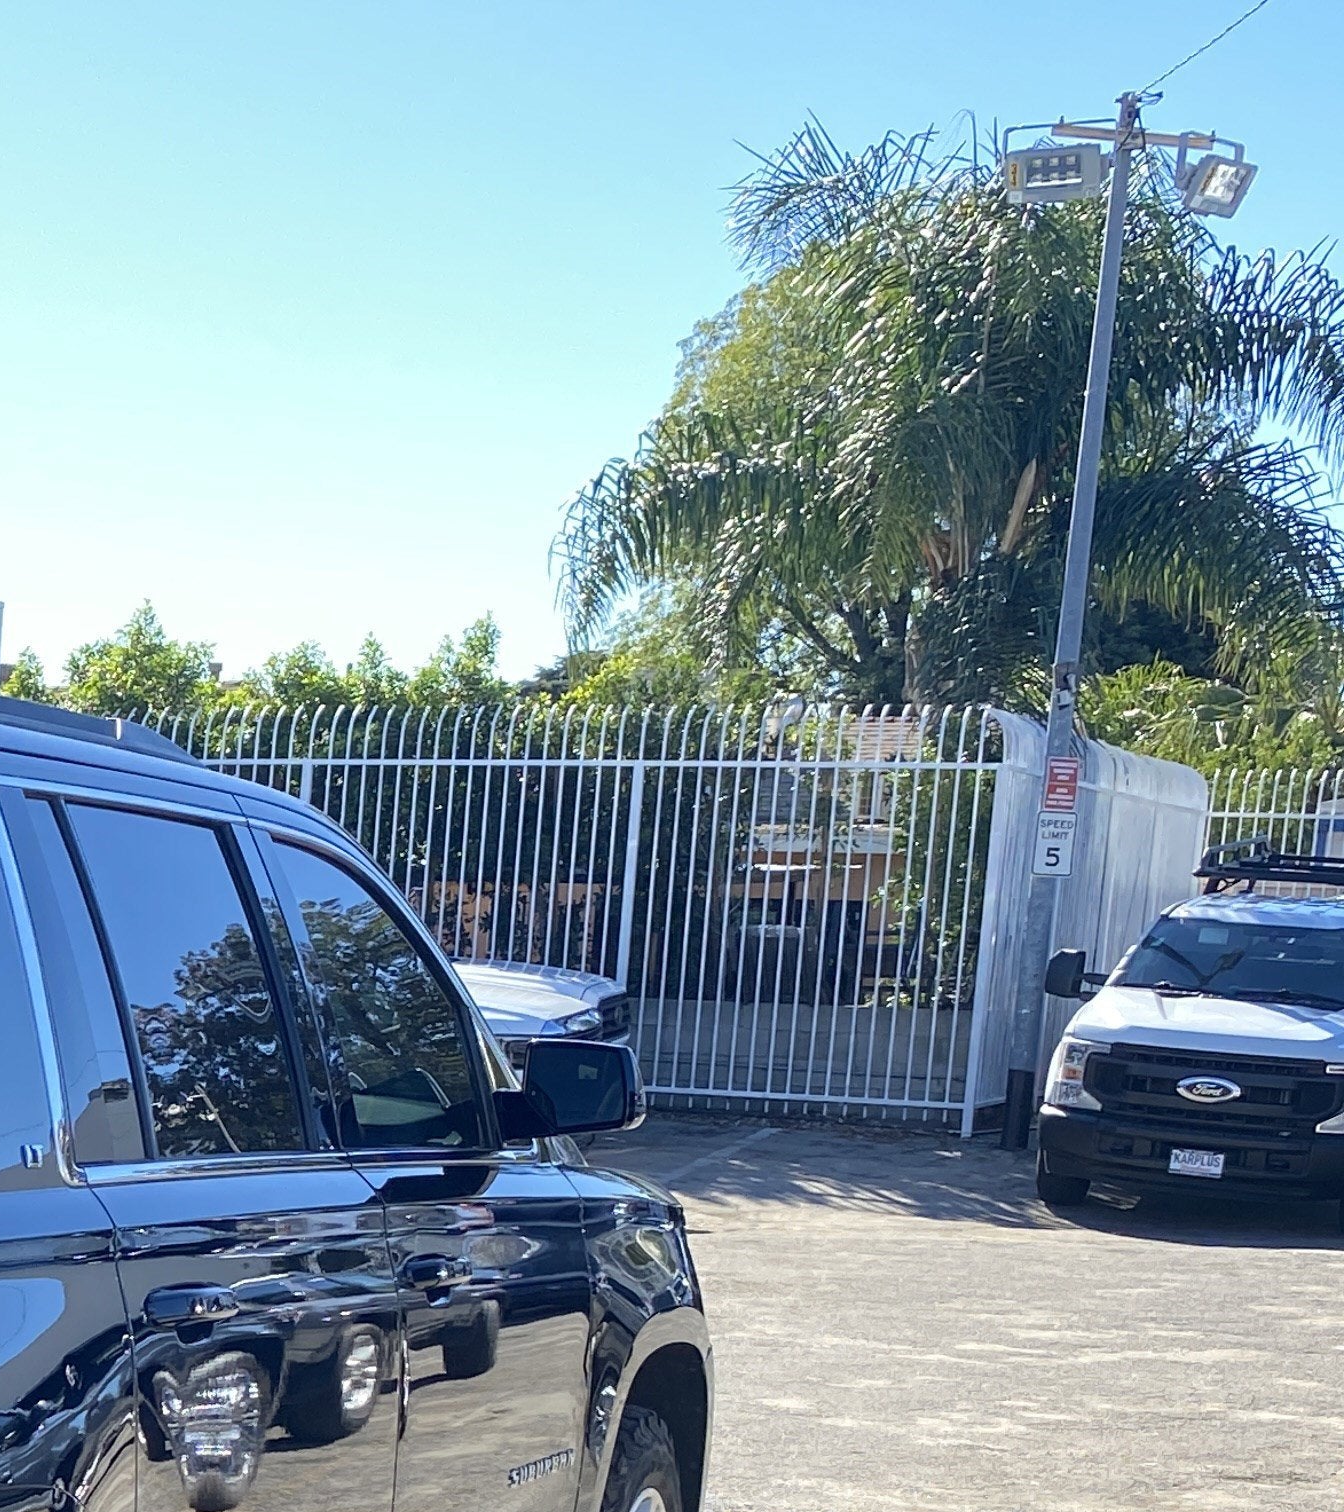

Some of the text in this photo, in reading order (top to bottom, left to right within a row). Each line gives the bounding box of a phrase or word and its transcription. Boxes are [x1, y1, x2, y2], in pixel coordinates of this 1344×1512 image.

[1040, 818, 1074, 830] SPEED
[1041, 831, 1069, 840] LIMIT
[1045, 847, 1061, 867] 5
[1193, 1083, 1224, 1097] Ford
[1172, 1152, 1221, 1168] KARPLUS
[507, 1448, 575, 1488] SUBURBAN
